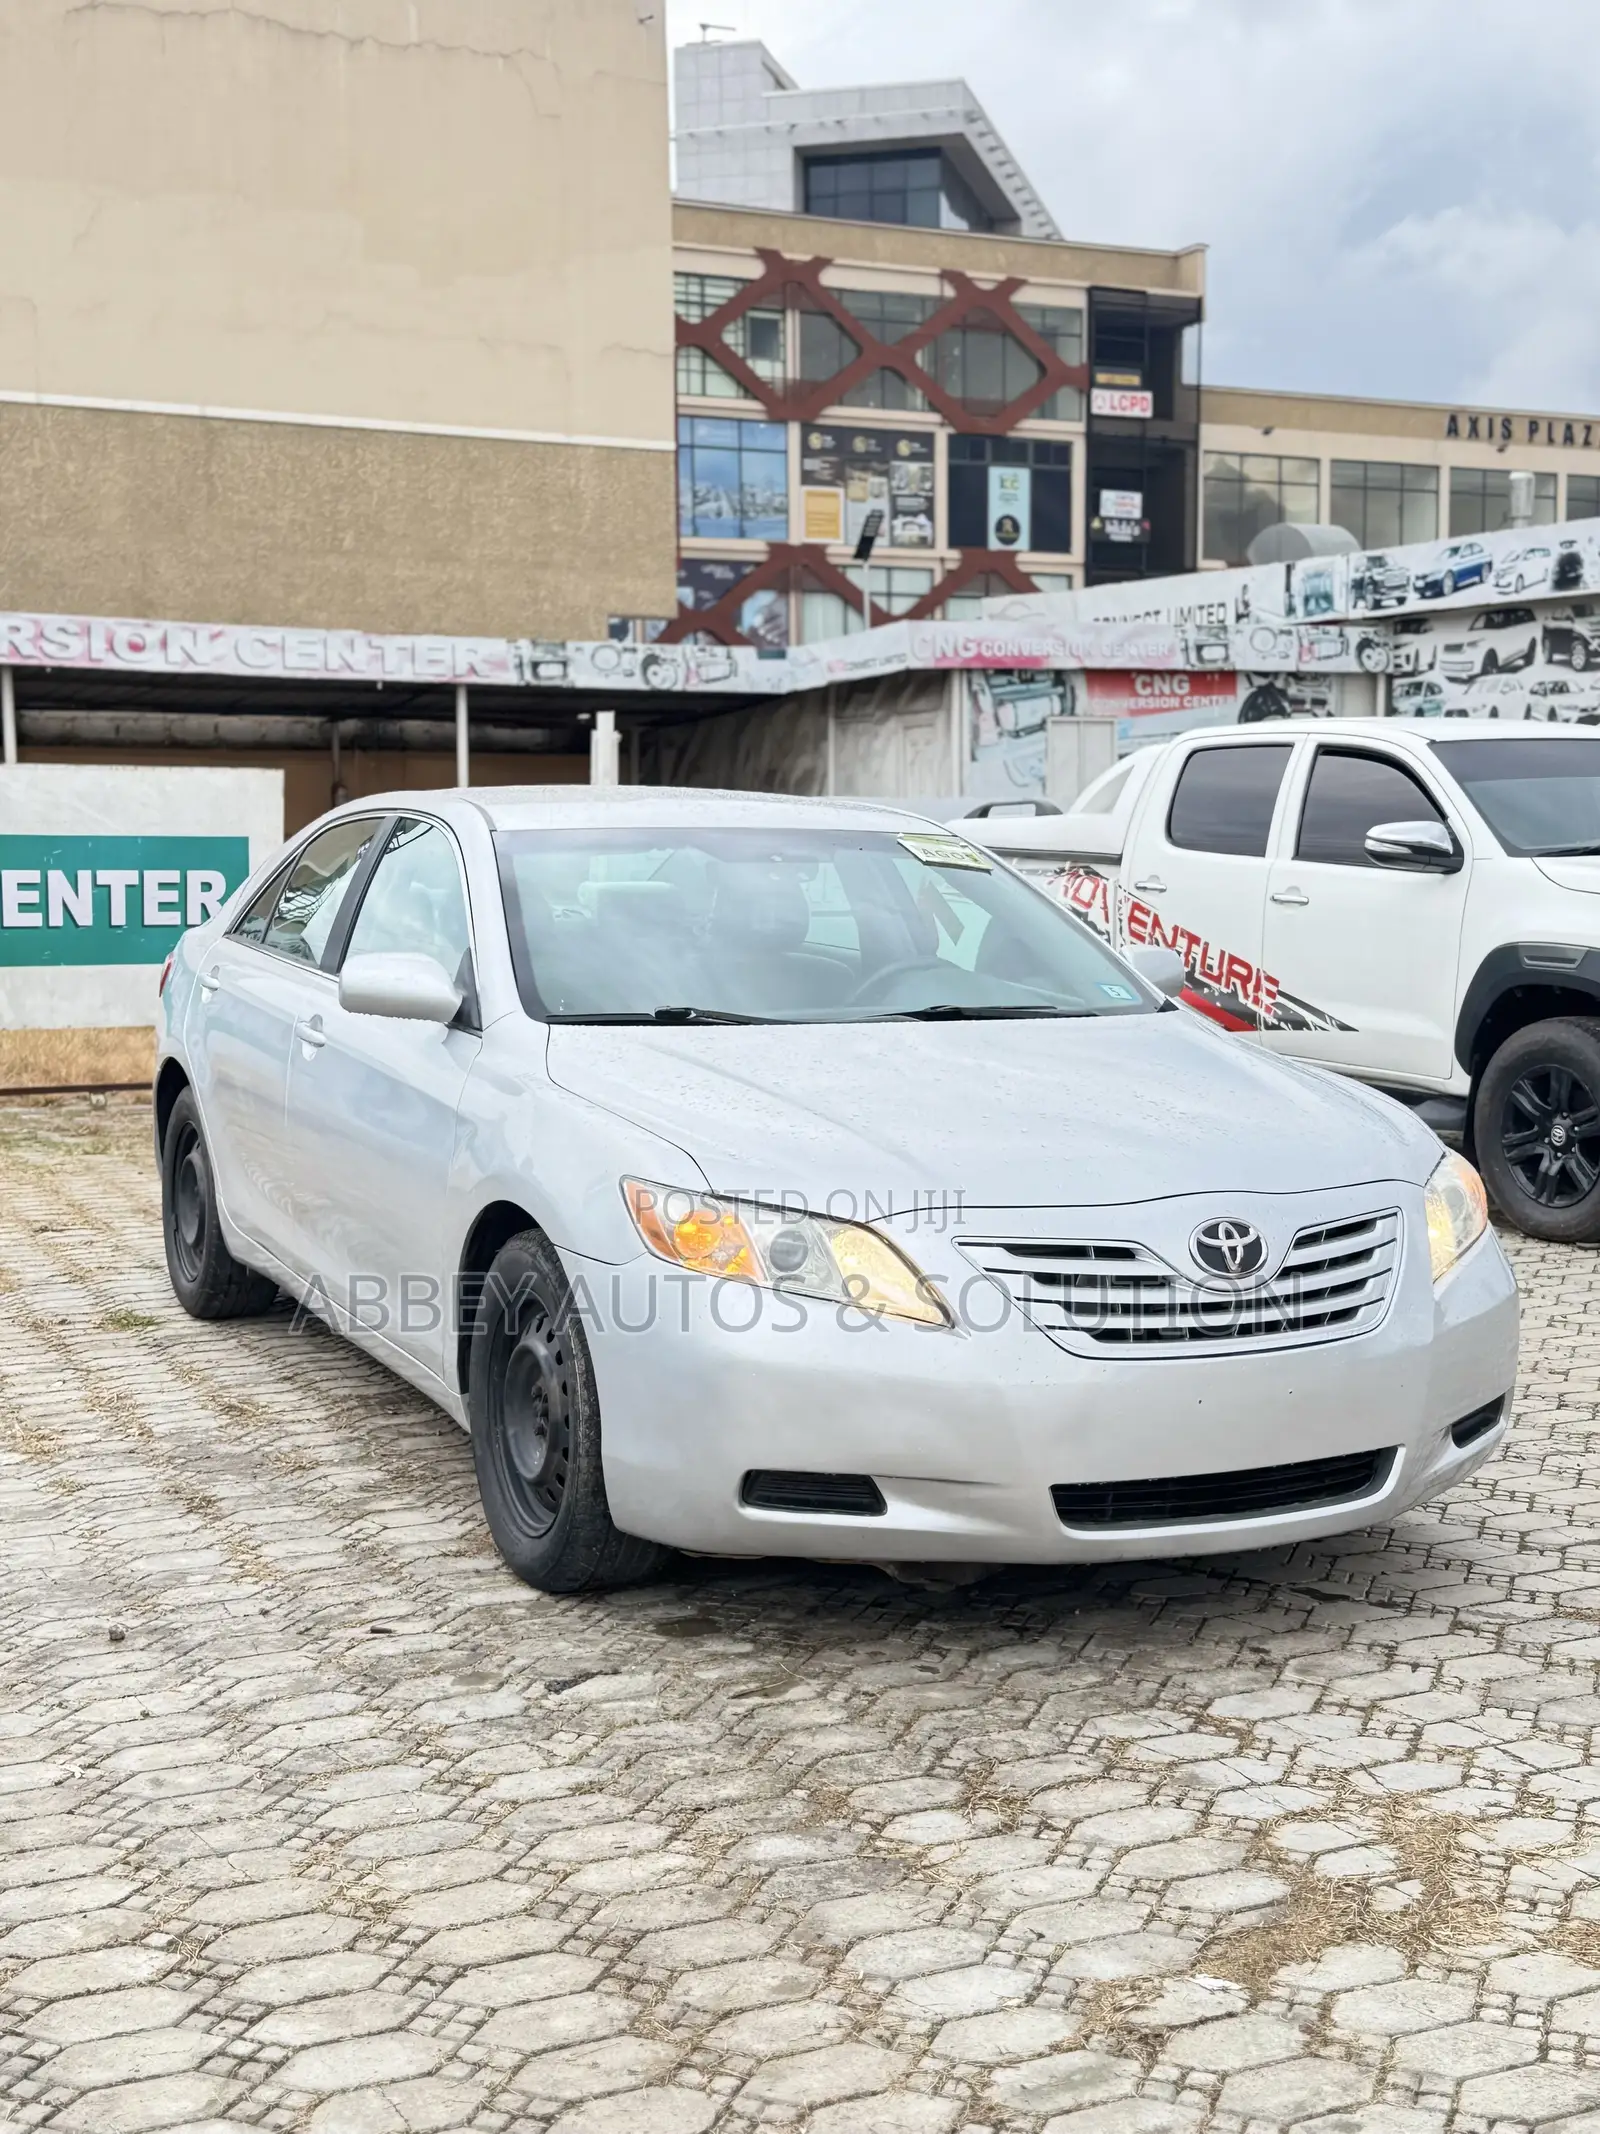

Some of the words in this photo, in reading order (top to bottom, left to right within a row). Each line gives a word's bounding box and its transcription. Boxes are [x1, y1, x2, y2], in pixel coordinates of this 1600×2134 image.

[1109, 393, 1150, 412] LCPD
[1446, 413, 1512, 440] AXIS
[1527, 419, 1600, 448] PLAZ
[234, 629, 492, 678] CENTER
[911, 632, 980, 661] CNG
[1134, 673, 1191, 696] CNG
[1, 869, 227, 928] ENTER
